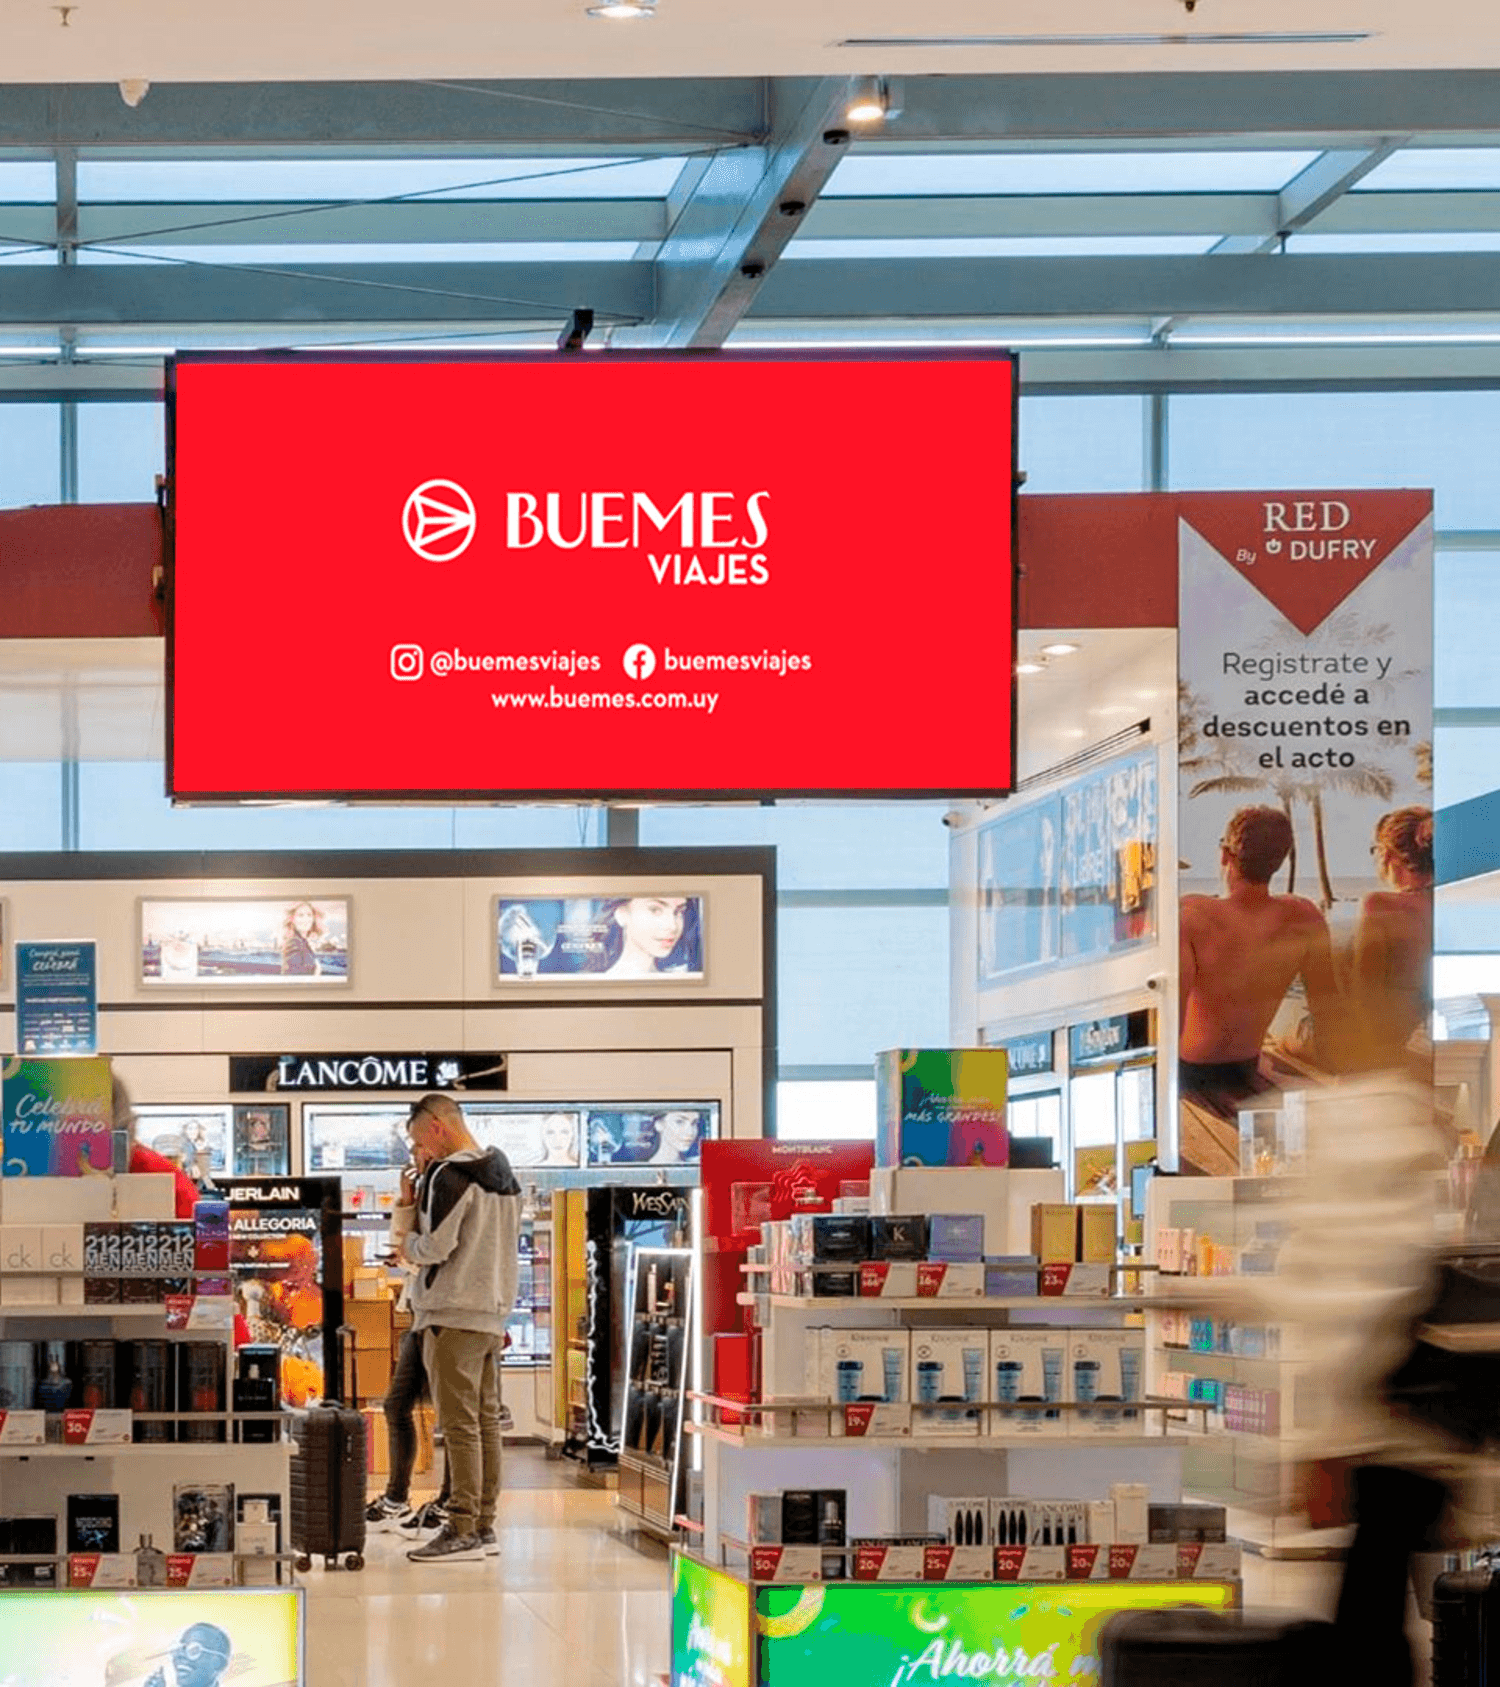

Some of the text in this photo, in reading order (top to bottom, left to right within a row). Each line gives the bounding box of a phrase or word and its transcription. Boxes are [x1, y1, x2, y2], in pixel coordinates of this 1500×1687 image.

[507, 492, 769, 548] BUEMES
[1263, 502, 1350, 532] RED
[1236, 539, 1376, 565] By DUFRY
[648, 554, 768, 584] VIAJES
[431, 648, 811, 676] @buemesviajes buemesviajes
[1223, 653, 1392, 681] Registrate y
[492, 686, 718, 713] www.buemes.com.uy
[1244, 683, 1369, 705] accedé a
[1202, 715, 1411, 738] descuentos en
[1259, 746, 1355, 768] el acto
[277, 1056, 428, 1085] LANCÔME
[9, 1119, 106, 1134] TU MUNDO
[215, 1187, 300, 1201] UERLAIN
[234, 1217, 317, 1231] ALLEGORIA
[86, 1235, 120, 1250] 212
[122, 1235, 158, 1250] 212
[159, 1234, 195, 1251] 212
[7, 1242, 31, 1269] ck
[49, 1241, 73, 1269] ck
[86, 1251, 120, 1265] MEN
[122, 1251, 157, 1265] MEN
[159, 1251, 194, 1265] MEN
